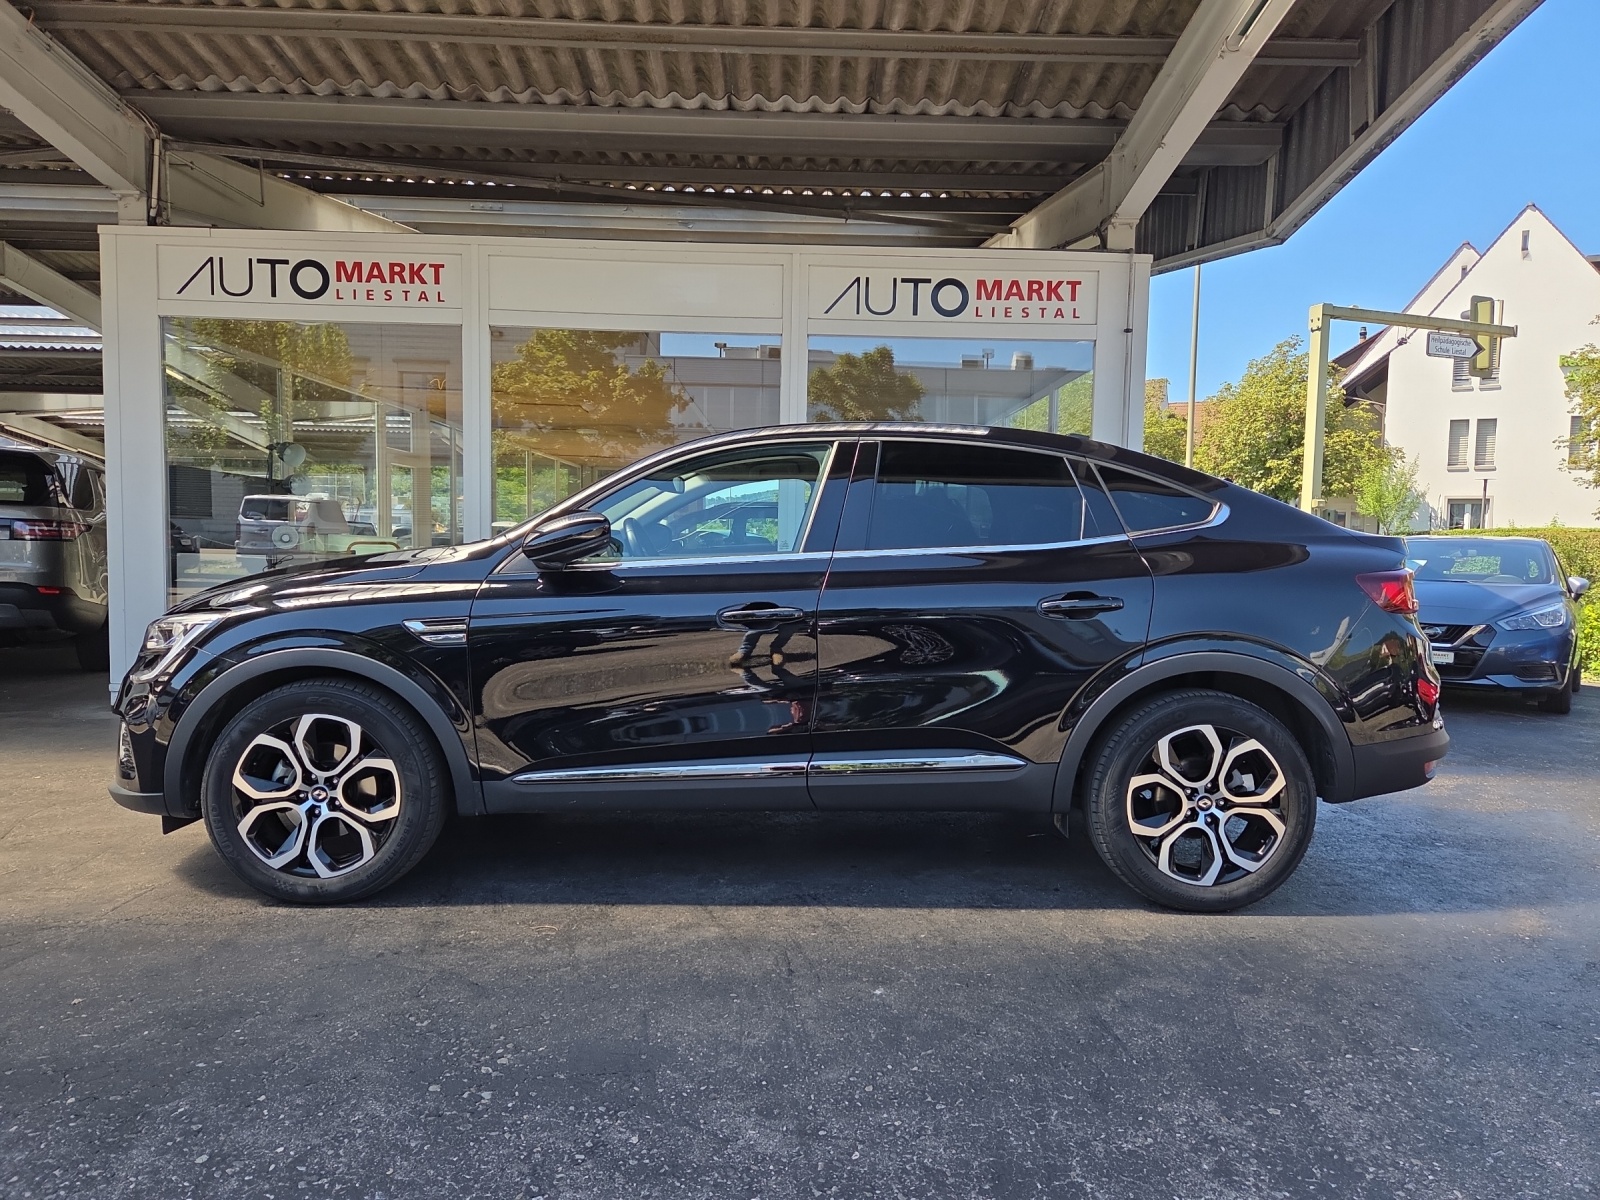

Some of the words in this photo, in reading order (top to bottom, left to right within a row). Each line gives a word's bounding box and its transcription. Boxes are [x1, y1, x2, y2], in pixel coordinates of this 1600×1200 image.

[176, 256, 330, 300] AUTO
[335, 261, 445, 285] MARKT
[336, 289, 446, 303] LIESTAL
[823, 276, 970, 318] AUTO
[975, 279, 1082, 302] MARKT
[975, 306, 1080, 319] LIESTAL
[1430, 335, 1472, 347] Heilpädagogische
[1434, 345, 1450, 354] Schule
[1451, 347, 1467, 355] Liestal
